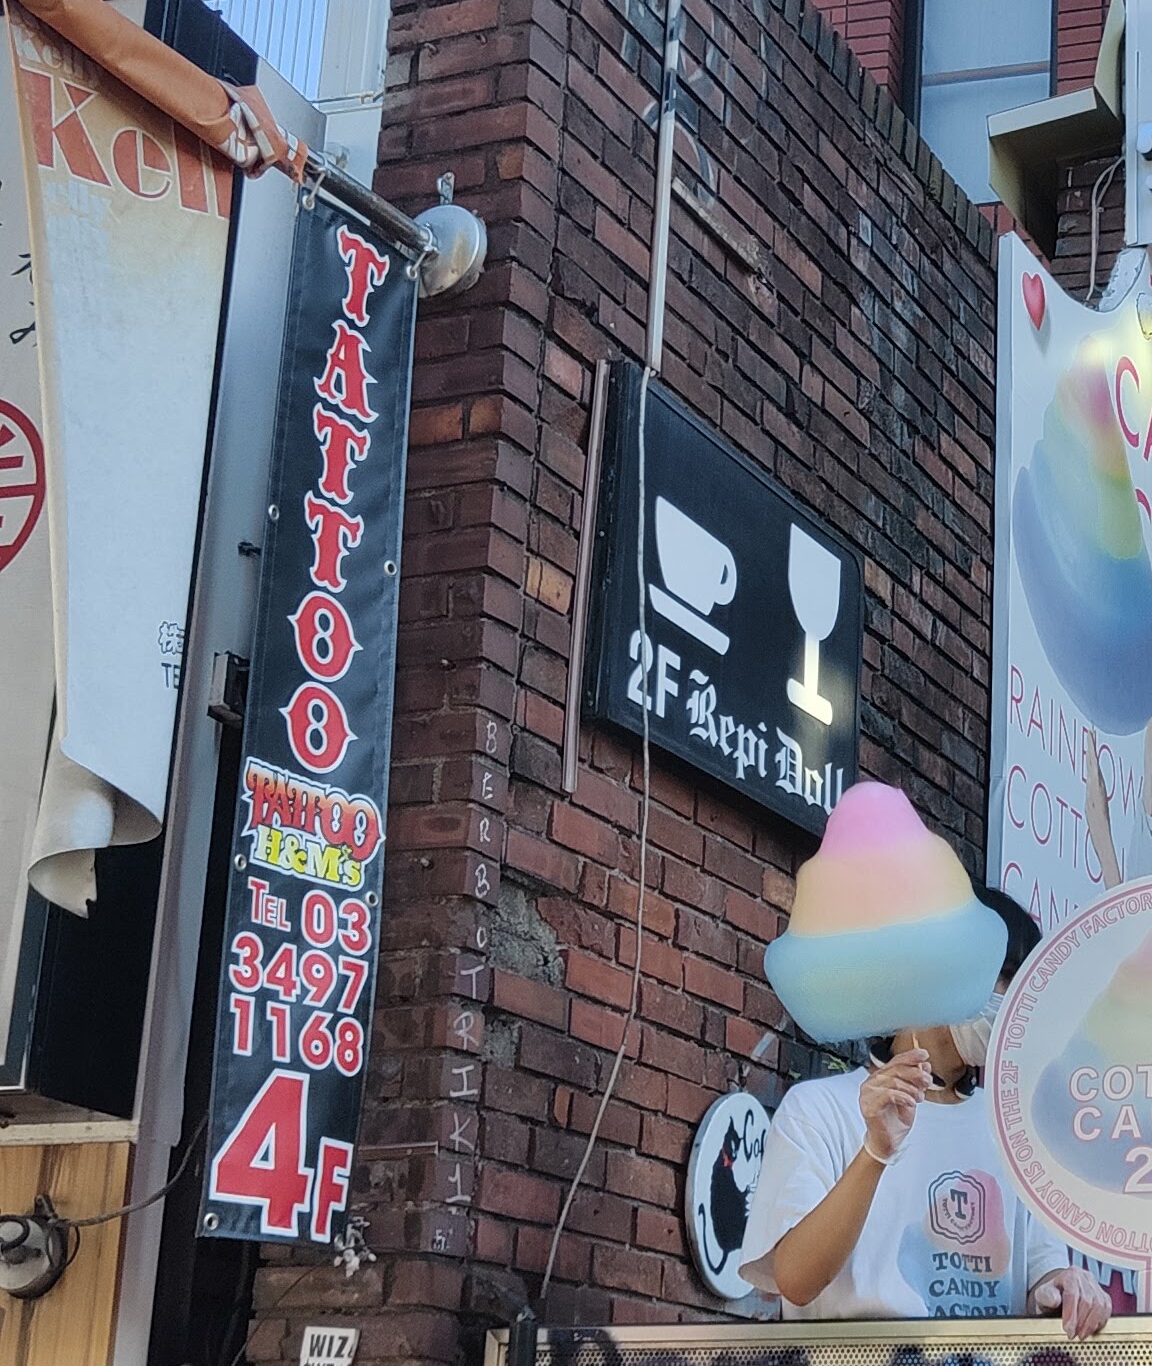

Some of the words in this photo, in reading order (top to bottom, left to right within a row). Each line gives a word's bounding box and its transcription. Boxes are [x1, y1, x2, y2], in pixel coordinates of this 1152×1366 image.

[277, 225, 390, 774] TATTOO
[626, 629, 681, 719] 2F
[686, 670, 768, 781] Repi
[241, 757, 386, 862] TATTOO
[302, 890, 371, 953] 03
[229, 932, 367, 1016] 3497
[1004, 991, 1041, 1051] TOTTI
[1029, 931, 1080, 993] CANDY
[231, 992, 362, 1079] 1168
[1000, 1060, 1019, 1085] 2F
[1001, 1088, 1022, 1131] THE
[210, 1072, 352, 1242] 4F
[1009, 1129, 1034, 1162] ON
[1023, 1161, 1045, 1184] IS
[950, 1189, 968, 1220] T
[1037, 1180, 1096, 1233] CANDY
[929, 1277, 1000, 1298] CANDY
[932, 1251, 992, 1273] TOTTI
[309, 1334, 354, 1358] WIZ
